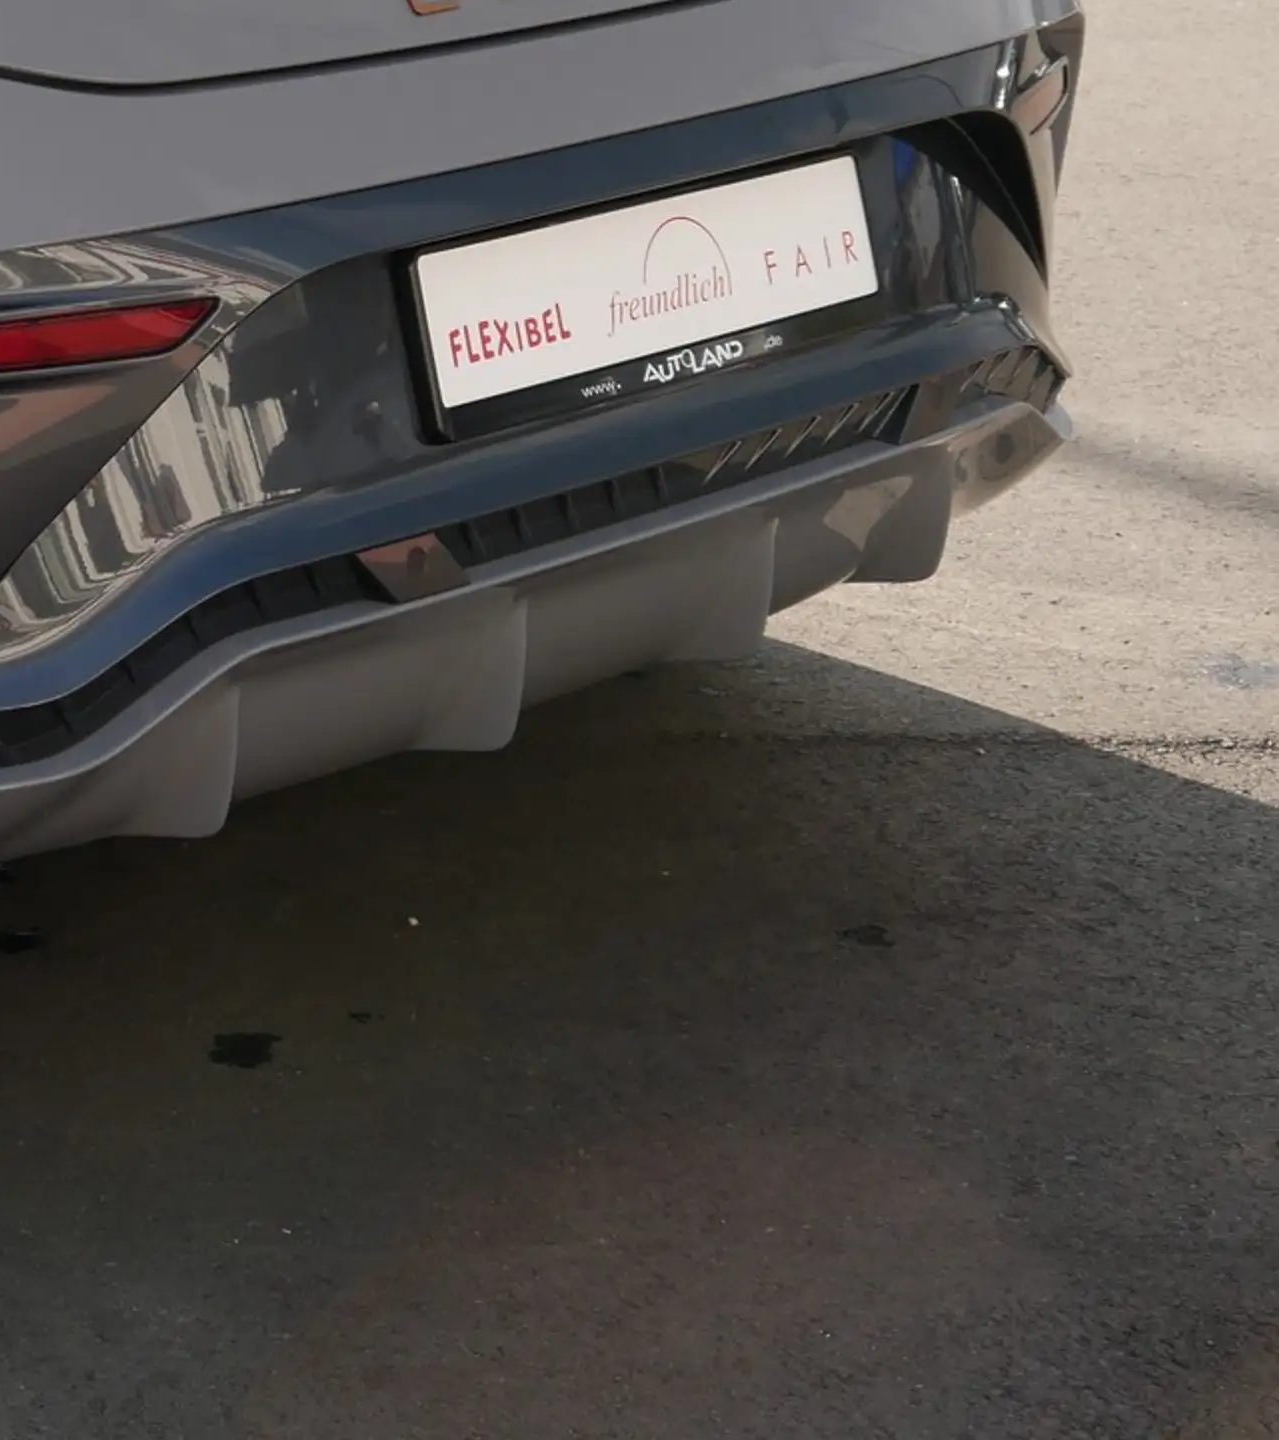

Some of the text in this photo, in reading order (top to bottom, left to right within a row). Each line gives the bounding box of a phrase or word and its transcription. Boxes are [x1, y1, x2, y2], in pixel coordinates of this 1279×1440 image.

[448, 230, 859, 368] FLEXIBEL freundlich FAIR
[643, 339, 744, 384] AUTOLAND
